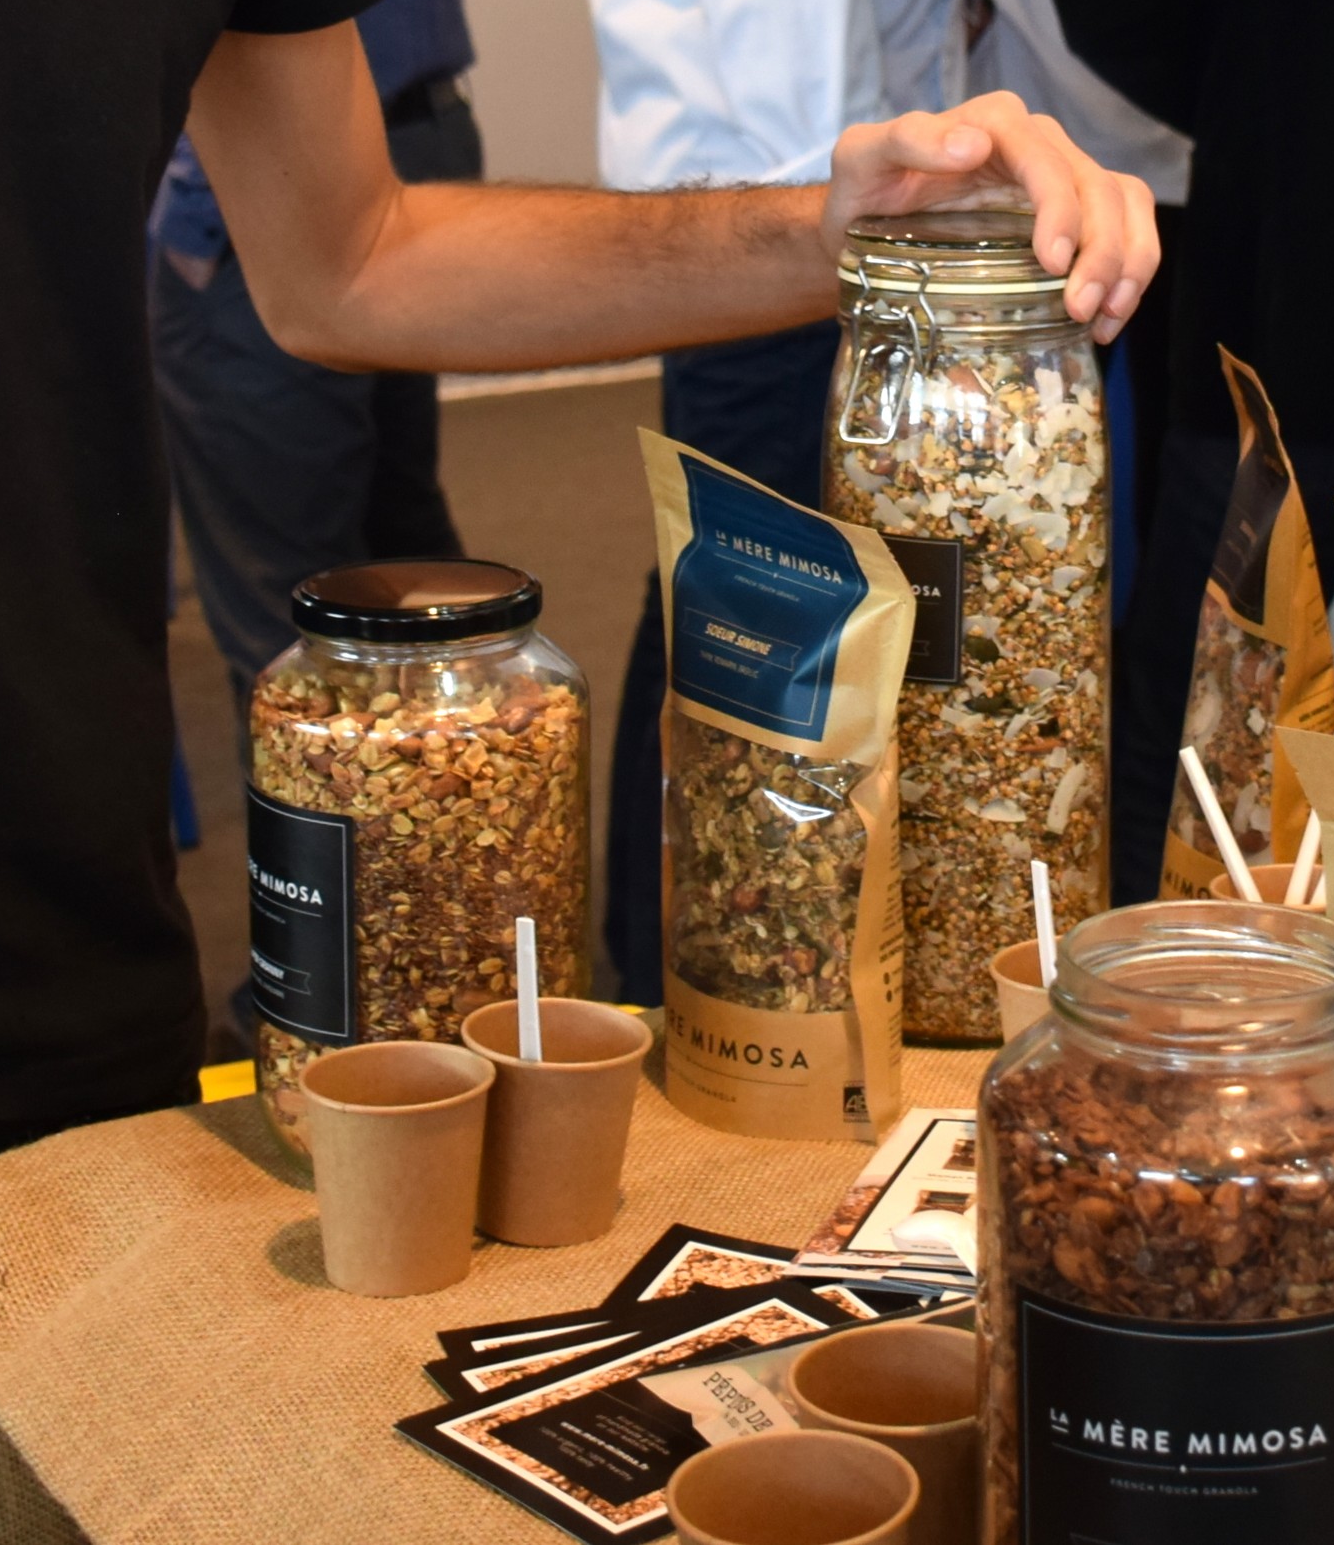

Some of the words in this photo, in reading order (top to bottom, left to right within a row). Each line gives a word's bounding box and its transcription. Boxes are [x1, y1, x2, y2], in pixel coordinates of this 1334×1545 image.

[733, 534, 773, 562] MÈRE
[778, 551, 844, 585] MIMOSA
[259, 871, 323, 906] MIMOSA
[691, 1025, 810, 1070] MIMOSA
[1049, 1407, 1069, 1426] LA
[1083, 1418, 1172, 1454] MÈRE
[1187, 1423, 1328, 1455] MIMOSA
